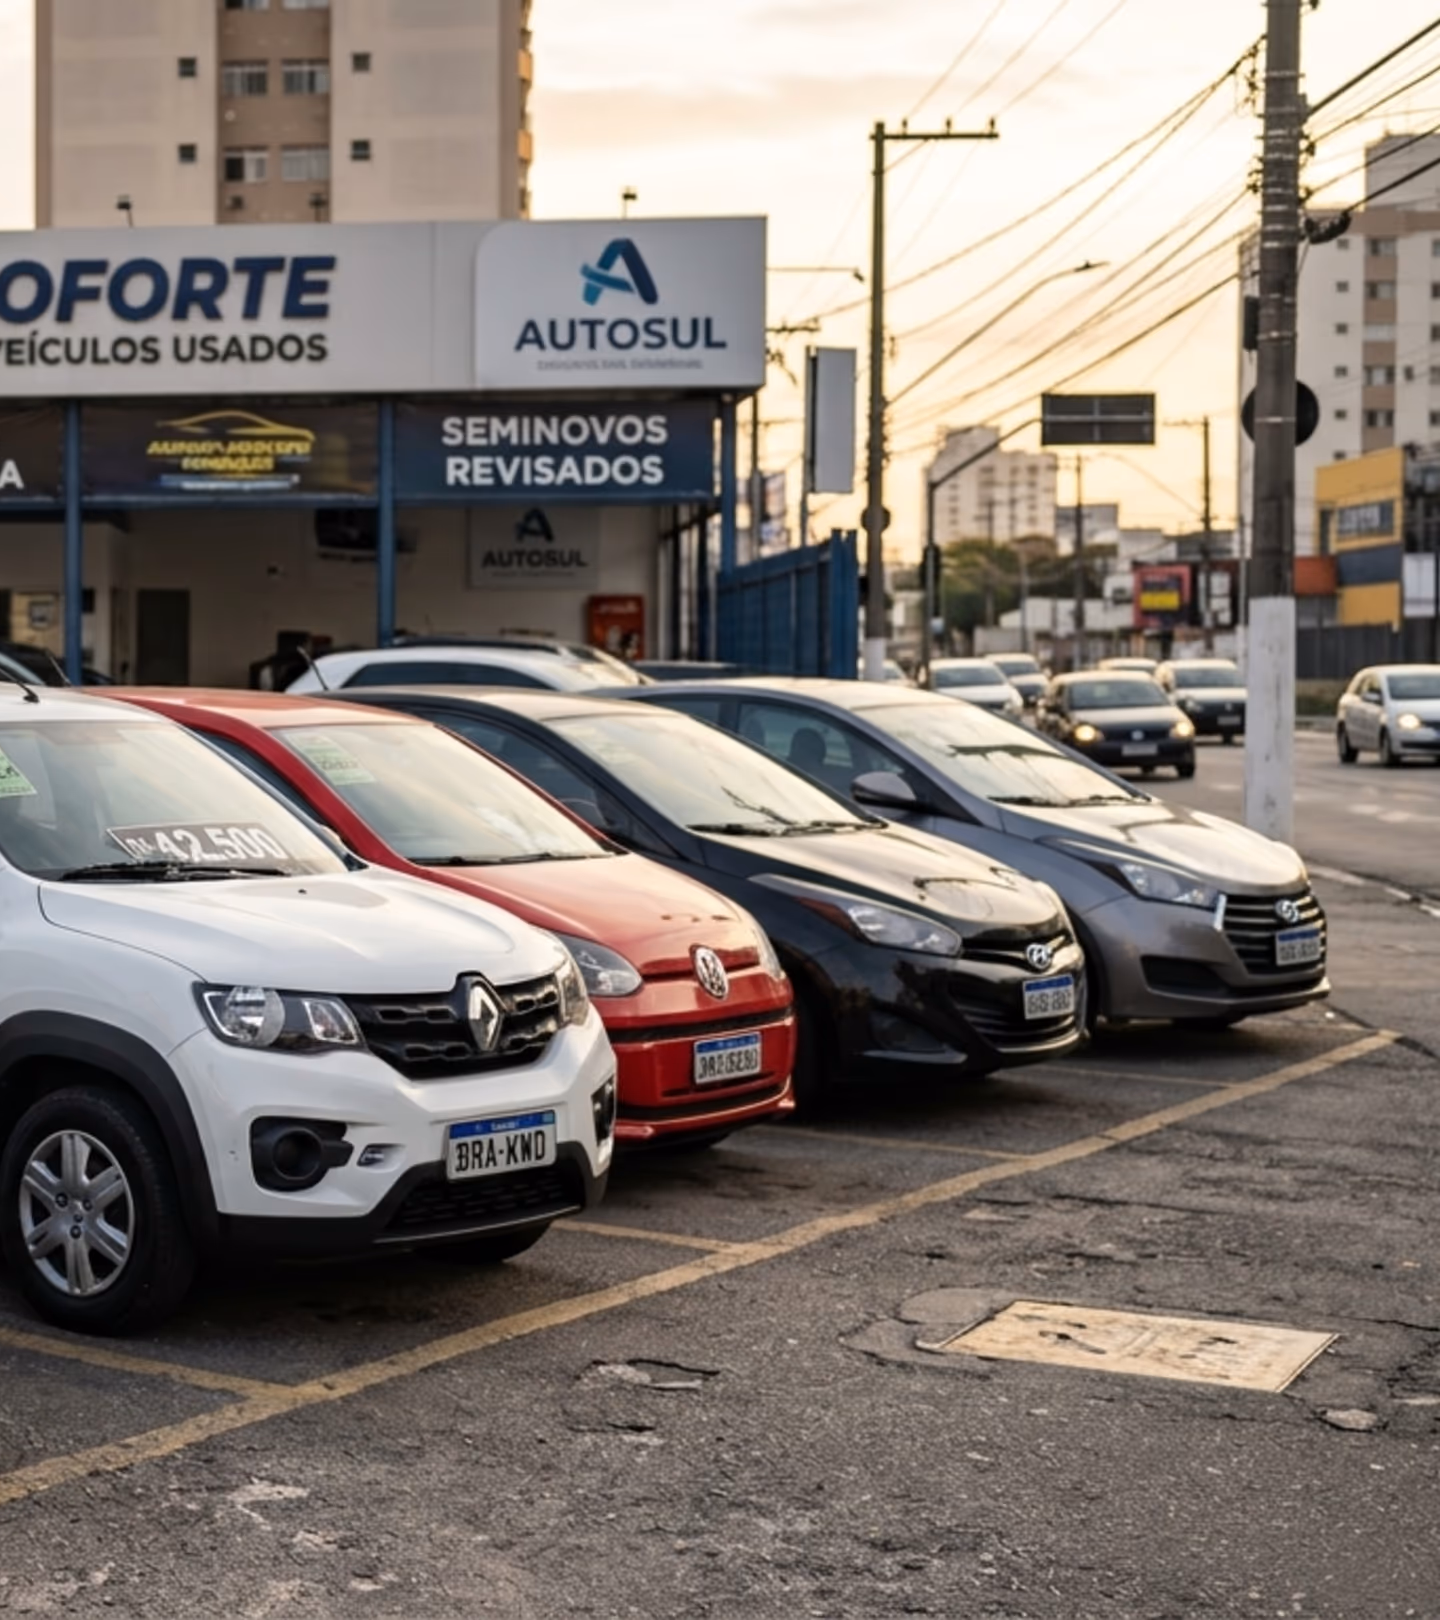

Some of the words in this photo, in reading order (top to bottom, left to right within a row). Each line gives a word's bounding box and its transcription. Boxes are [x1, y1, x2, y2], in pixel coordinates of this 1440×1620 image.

[173, 334, 327, 363] USADOS
[514, 317, 727, 351] AUTOSUL
[442, 414, 668, 446] SEMINOVOS
[446, 455, 664, 486] REVISADOS
[482, 550, 588, 568] AUTOSUL
